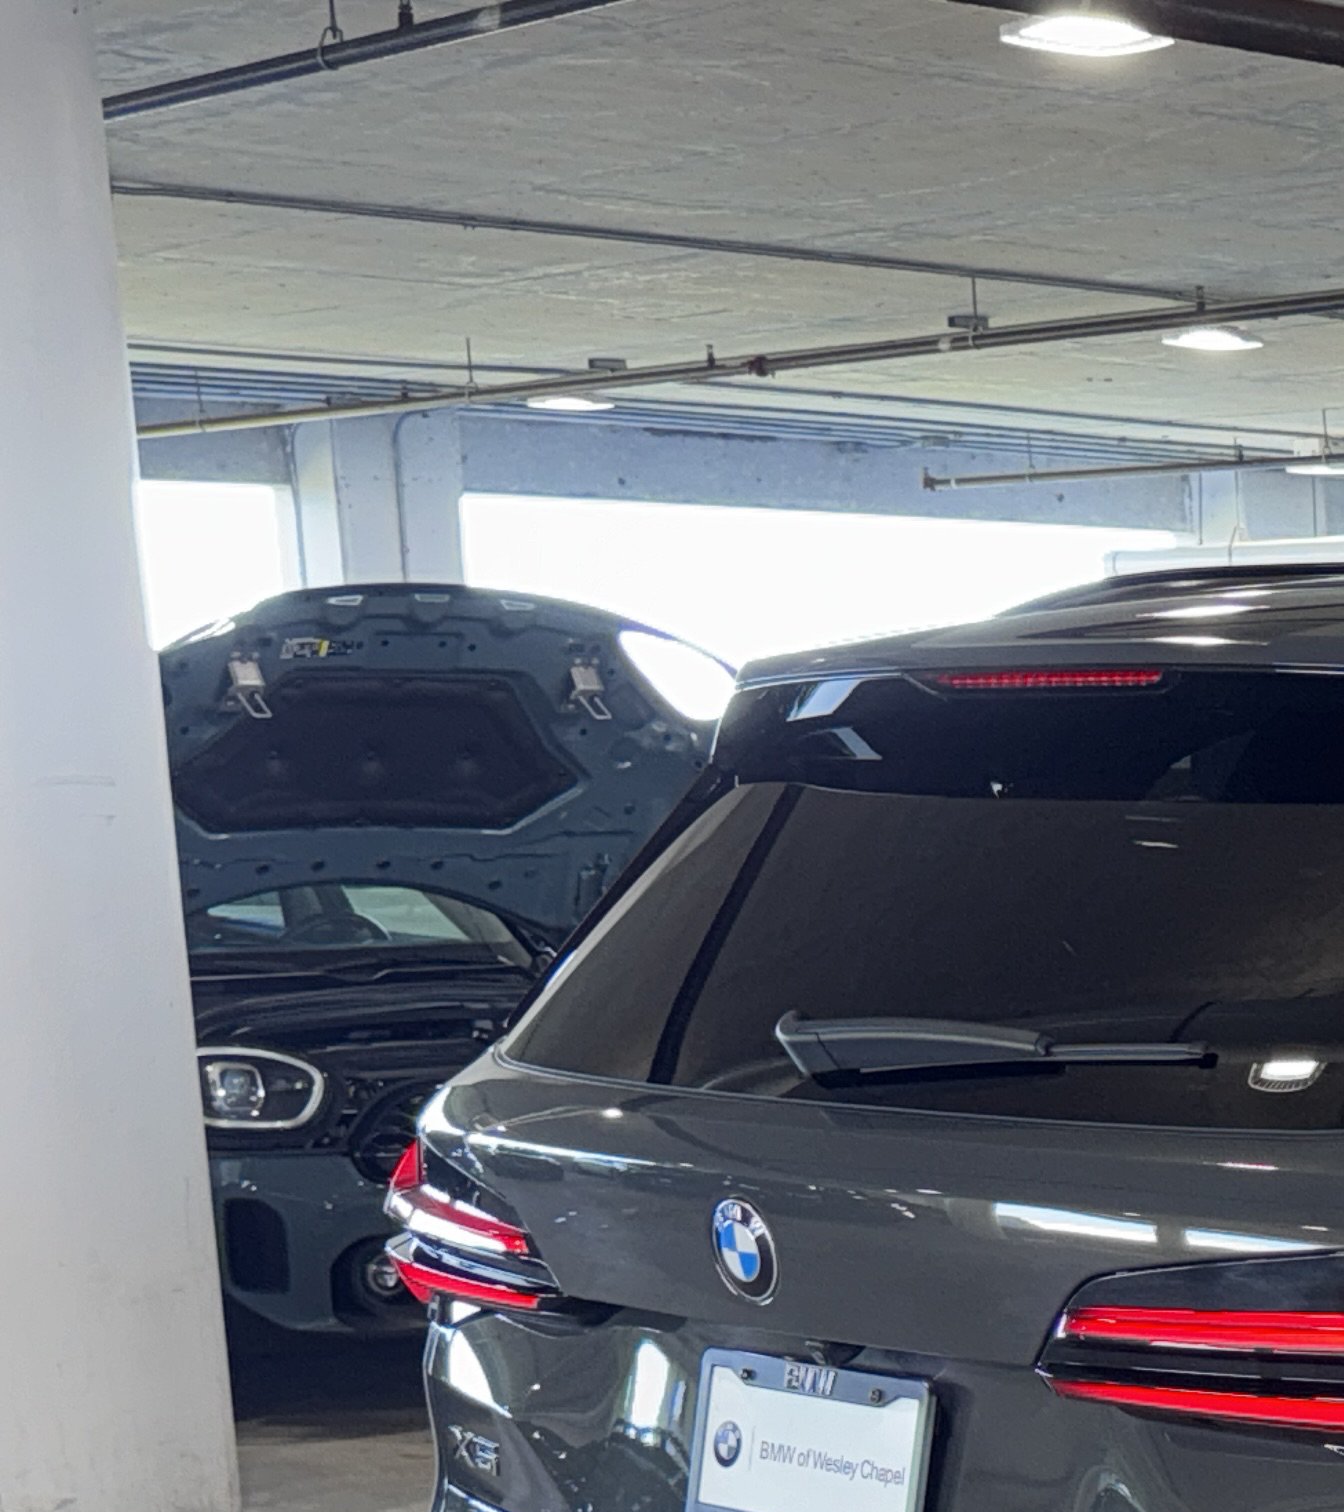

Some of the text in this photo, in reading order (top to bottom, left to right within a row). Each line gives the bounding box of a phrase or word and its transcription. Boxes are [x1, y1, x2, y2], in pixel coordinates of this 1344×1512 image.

[714, 1203, 766, 1238] BMW
[449, 1425, 500, 1476] X5
[760, 1440, 906, 1488] BMW of Wesley Chapel
